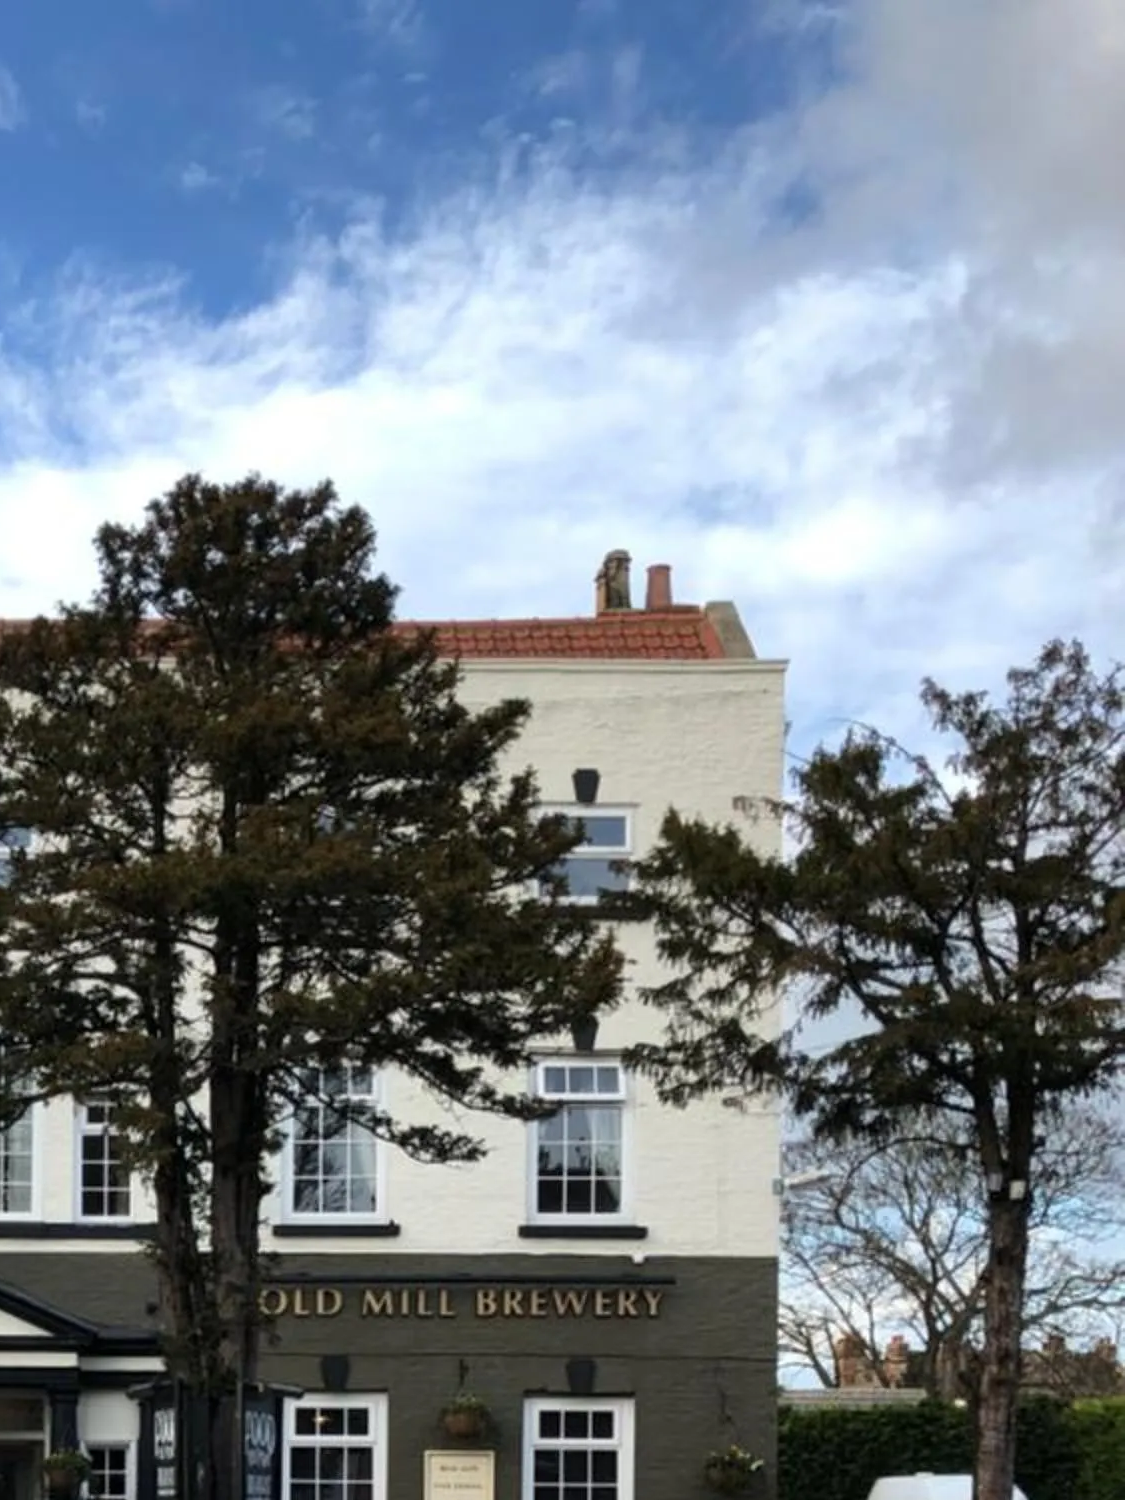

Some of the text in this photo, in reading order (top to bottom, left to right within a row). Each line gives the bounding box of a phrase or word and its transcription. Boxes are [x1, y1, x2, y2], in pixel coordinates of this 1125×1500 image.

[258, 1287, 663, 1317] OLD MILL BREWERY
